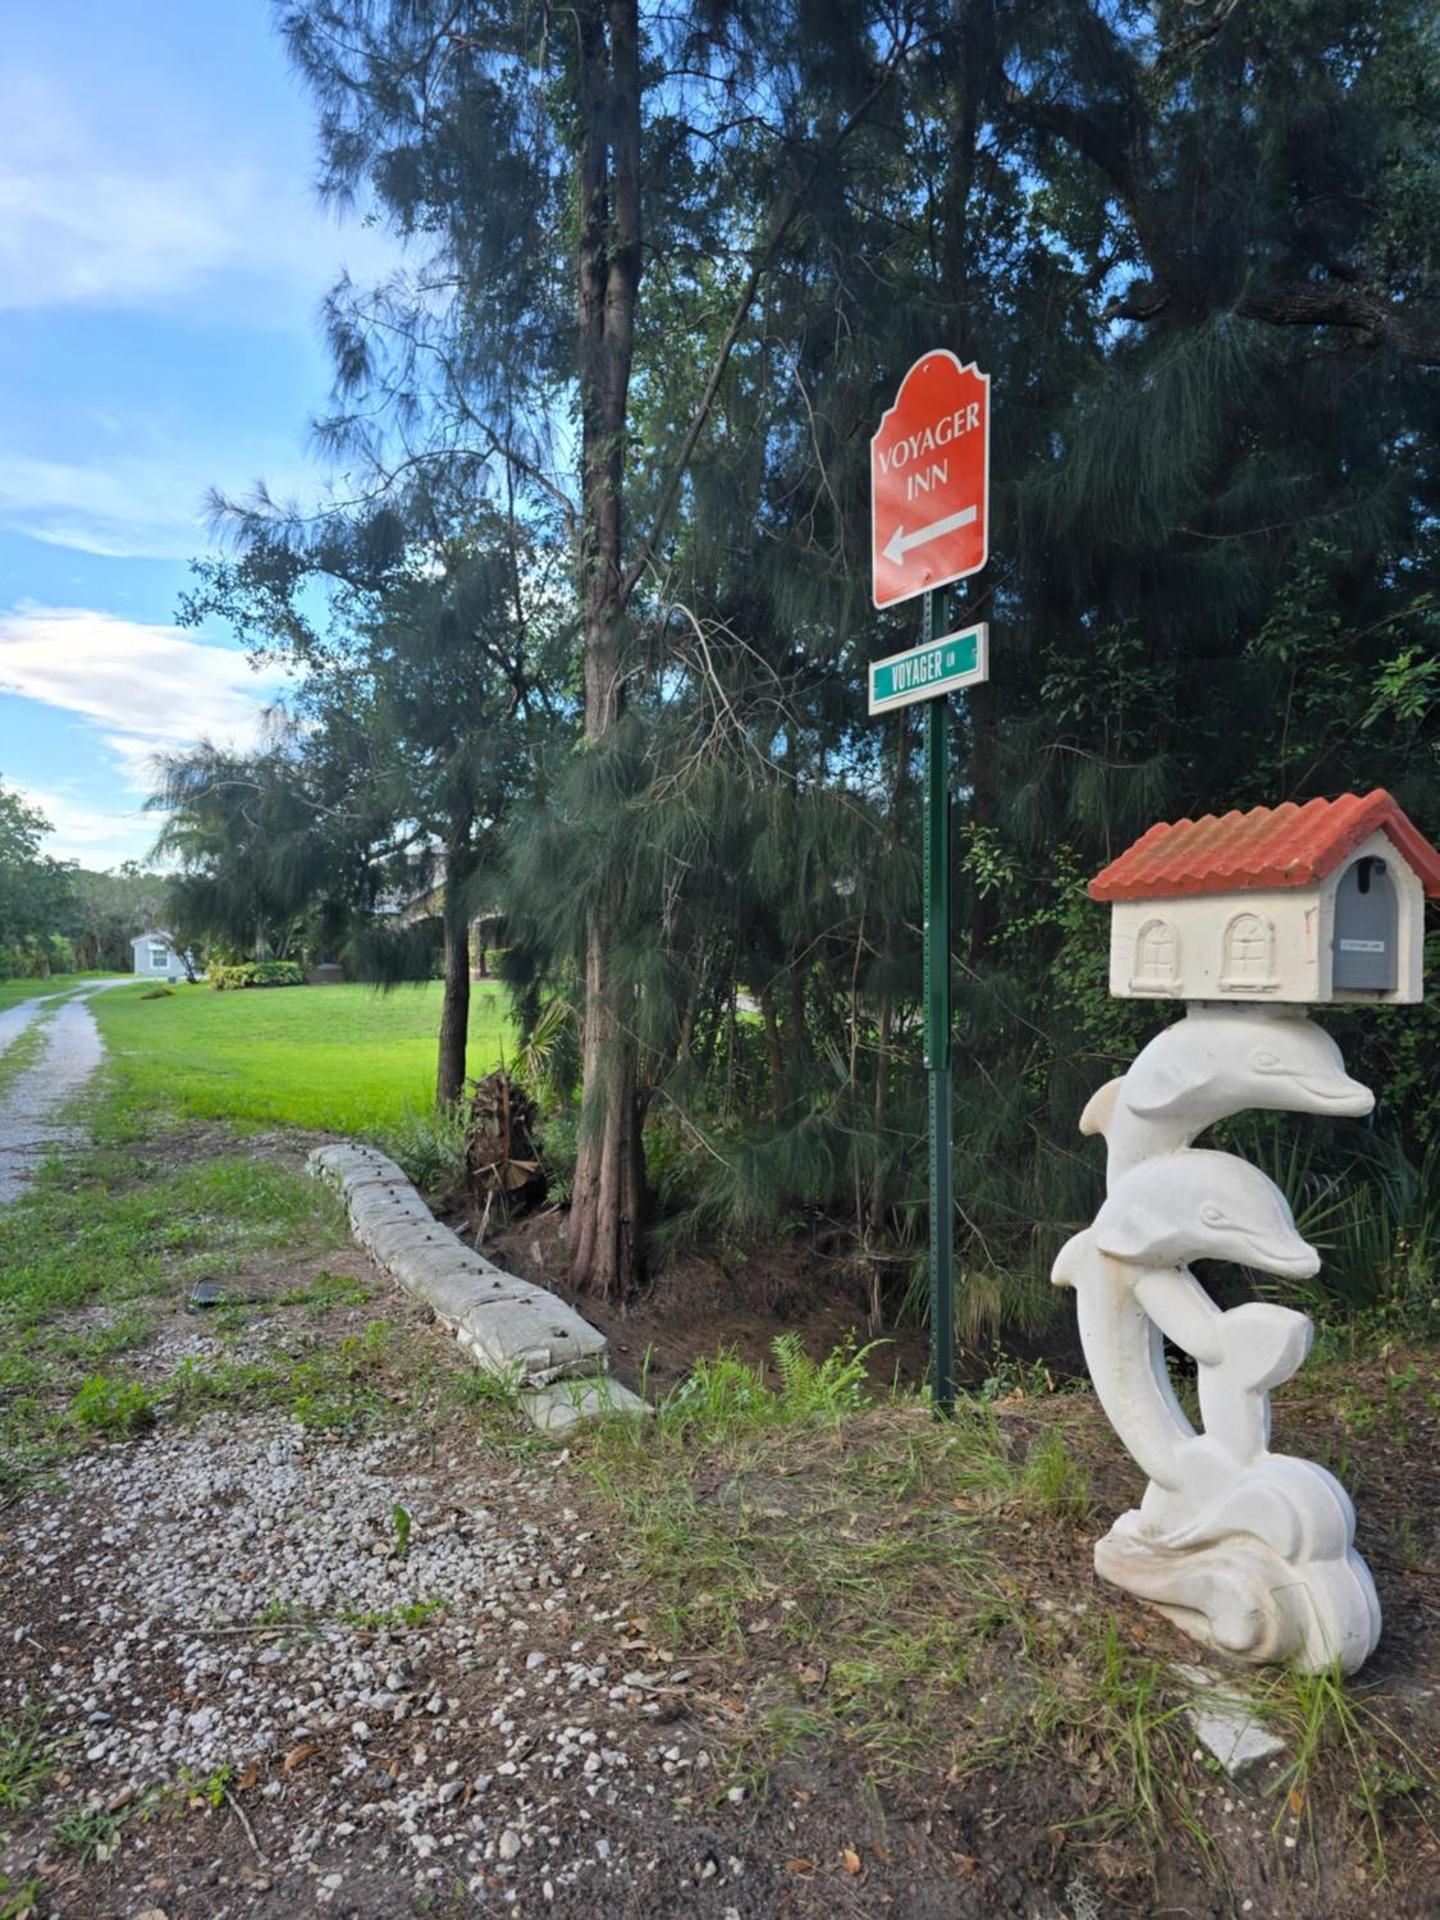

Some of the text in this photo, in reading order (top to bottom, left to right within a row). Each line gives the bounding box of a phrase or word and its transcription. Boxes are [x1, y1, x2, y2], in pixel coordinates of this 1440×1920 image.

[879, 402, 980, 475] VOYAGER
[907, 458, 948, 501] INN
[892, 651, 942, 692] VOYAGER
